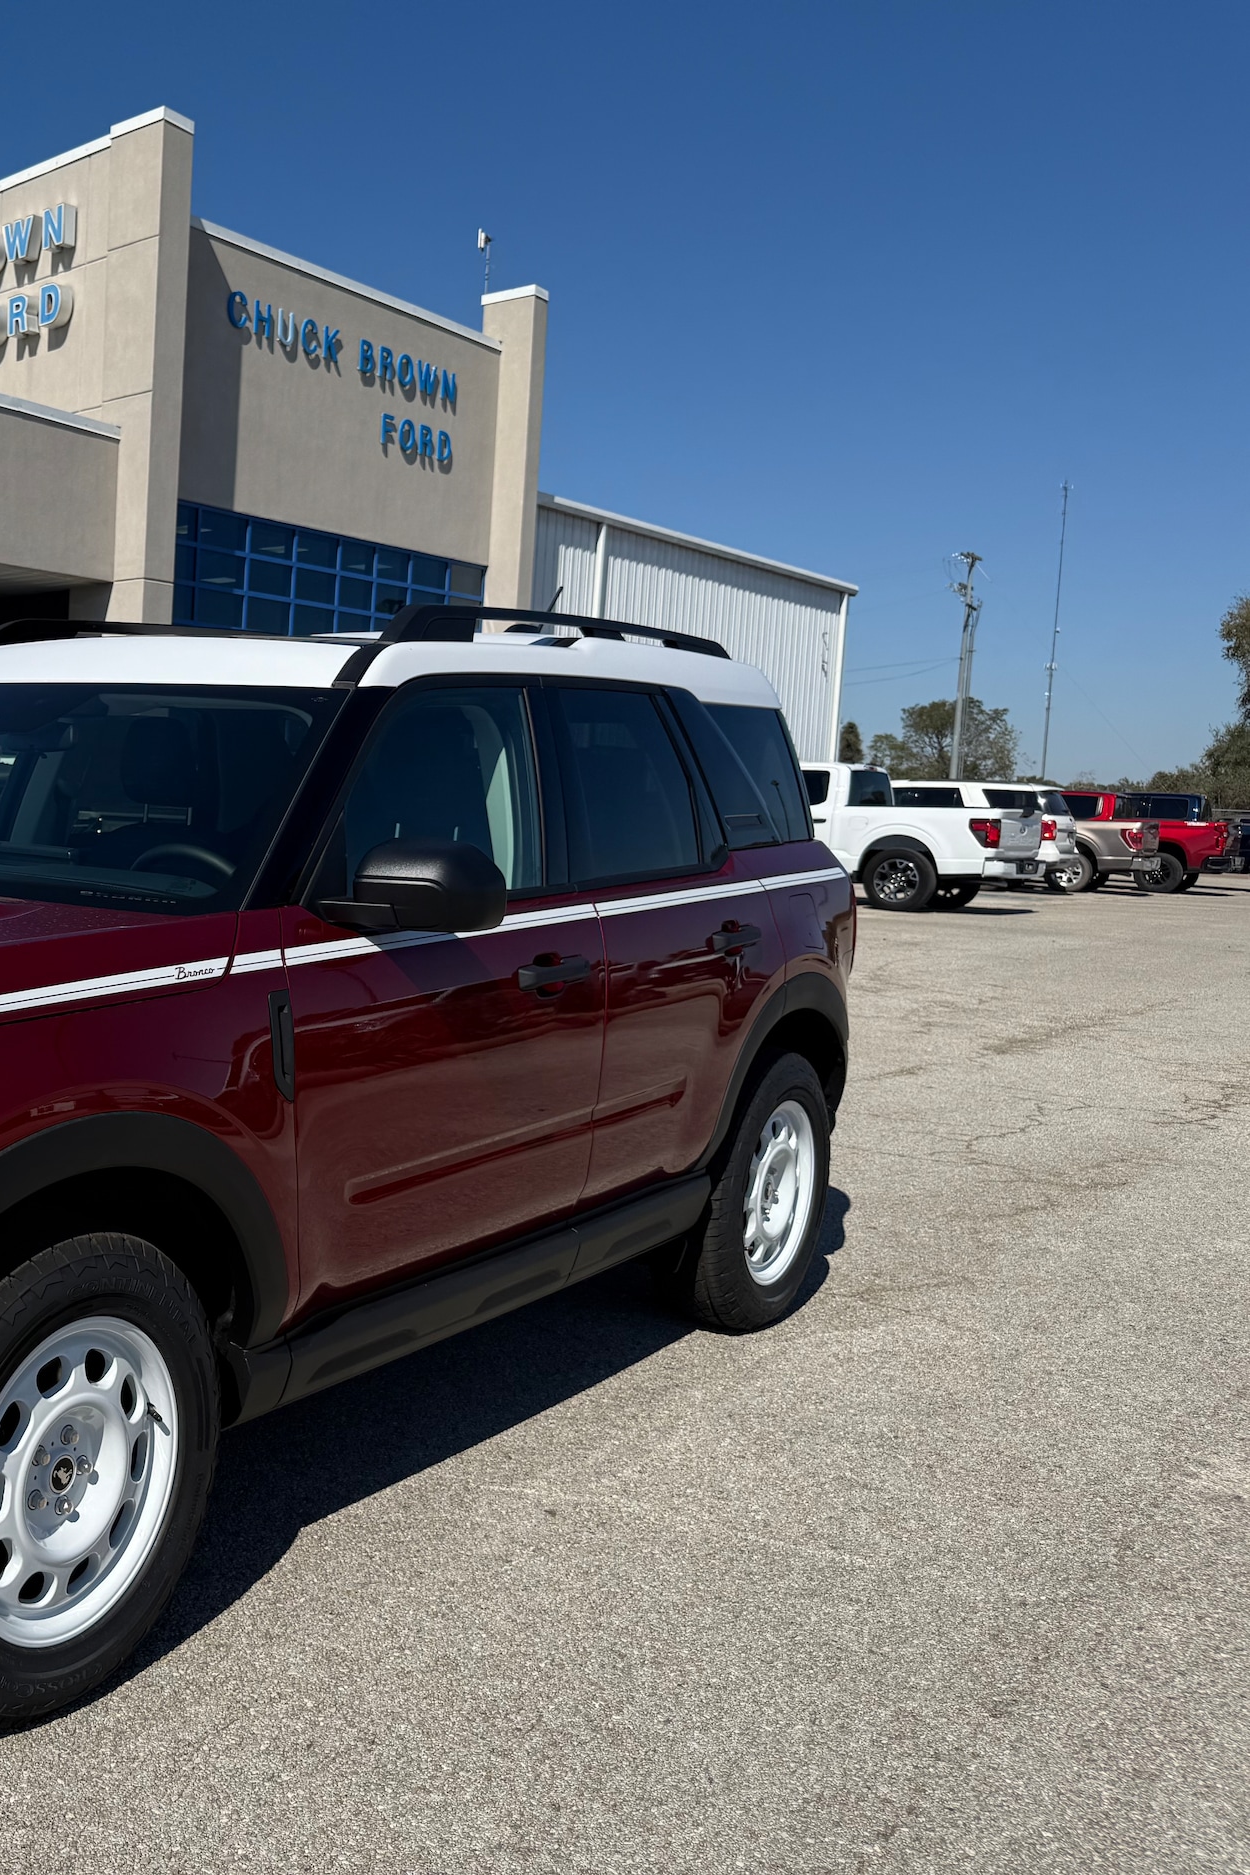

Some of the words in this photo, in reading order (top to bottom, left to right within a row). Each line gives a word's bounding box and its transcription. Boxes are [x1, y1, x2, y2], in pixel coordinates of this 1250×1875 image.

[227, 291, 340, 363] CHUCK
[357, 338, 456, 404] BROWN
[380, 413, 452, 462] FORD
[174, 966, 216, 980] Bronco
